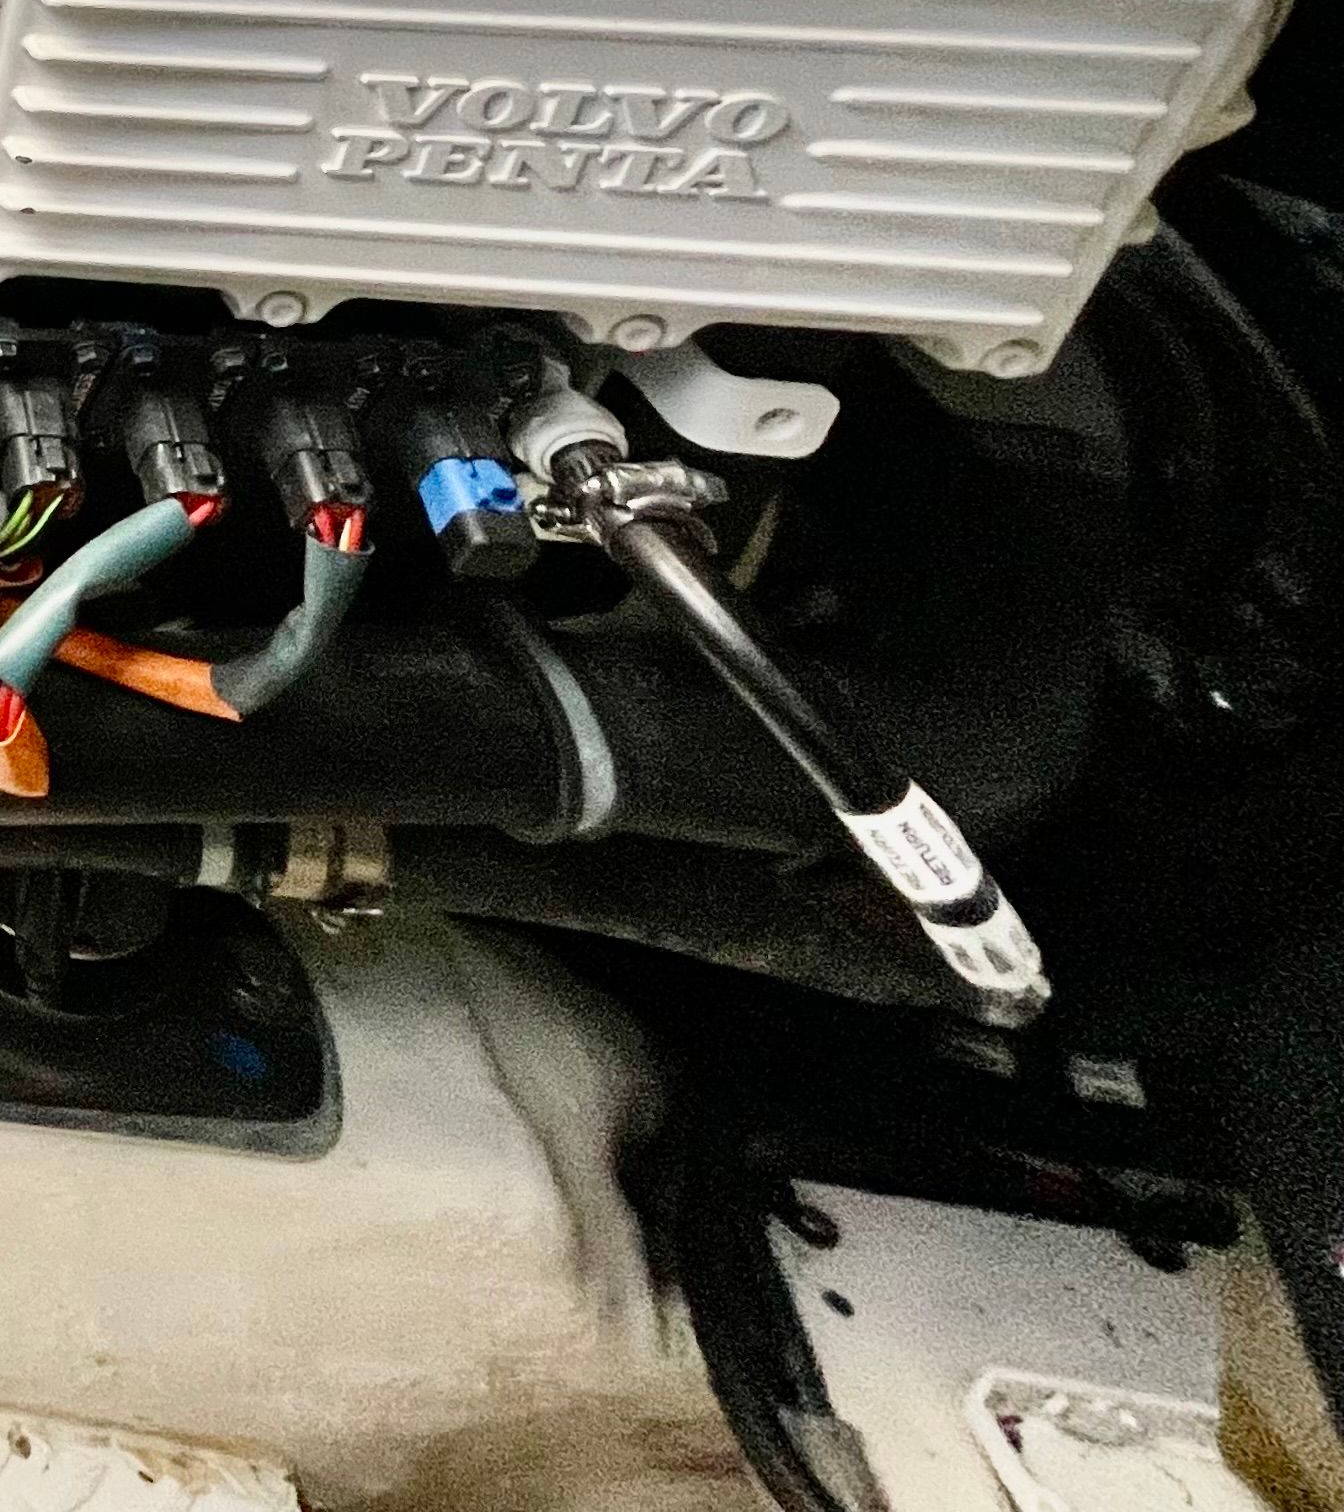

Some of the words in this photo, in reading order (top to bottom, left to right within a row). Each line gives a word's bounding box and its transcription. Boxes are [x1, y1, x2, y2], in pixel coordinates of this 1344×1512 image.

[360, 72, 790, 143] VOLVO
[321, 127, 771, 205] PENTA
[898, 821, 953, 886] RETURN
